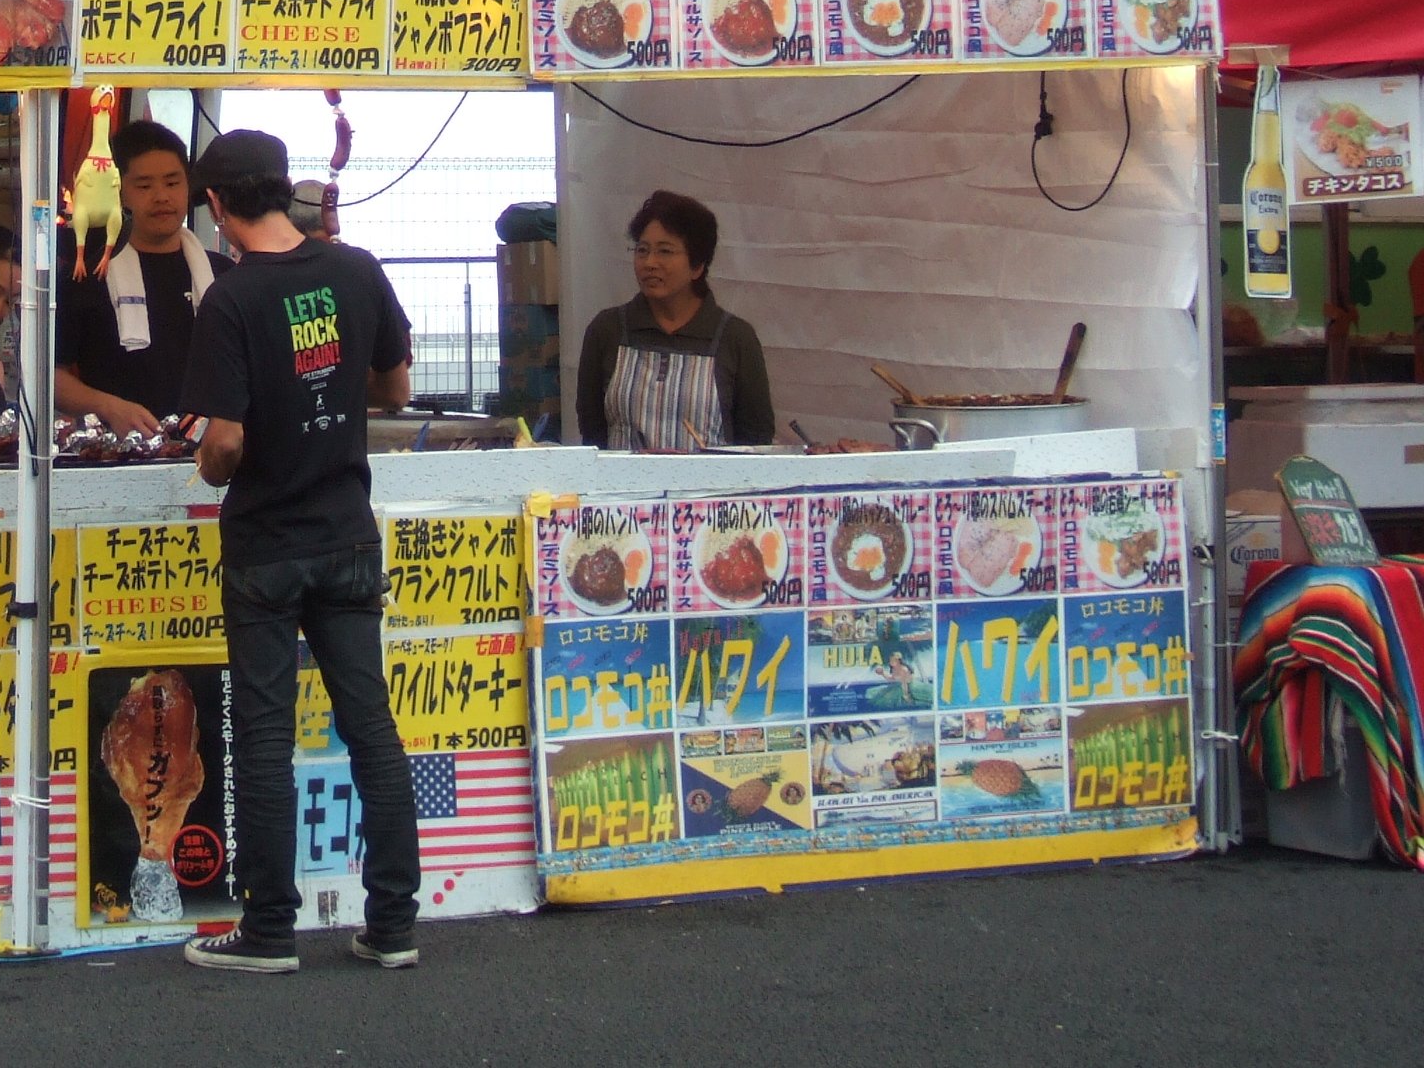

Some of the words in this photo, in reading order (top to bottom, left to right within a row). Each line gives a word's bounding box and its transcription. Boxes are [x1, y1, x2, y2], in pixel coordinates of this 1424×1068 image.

[81, 0, 223, 42] ポテトフライ!
[241, 26, 360, 43] CHEESE
[394, 10, 523, 56] ジャンボフランク!
[772, 35, 814, 62] 500円
[911, 28, 951, 55] 500円
[1047, 26, 1086, 53] 500円
[1176, 25, 1214, 51] 500円
[85, 52, 136, 65] にんにく!
[163, 44, 227, 67] 400円
[318, 47, 380, 70] 400円
[395, 57, 446, 70] Hawaii
[460, 57, 522, 72] 300円
[627, 38, 670, 67] 500円
[1308, 173, 1402, 194] チキンタコス
[1250, 191, 1283, 207] Corona
[283, 286, 337, 324] LET'S
[290, 314, 340, 352] ROCK
[295, 342, 342, 375] AGAIN!
[1231, 545, 1280, 564] Corona
[83, 560, 225, 593] チーズポテトフライ
[388, 561, 522, 607] フランクフルト!
[540, 543, 562, 616] デミソース
[676, 537, 693, 608] サルサソース
[891, 572, 931, 599] 500円
[1019, 566, 1057, 592] 500円
[1142, 559, 1181, 585] 500円
[627, 585, 667, 613] 500円
[761, 577, 803, 605] 500円
[84, 595, 208, 616] CHEESE
[460, 606, 520, 624] 300円
[166, 616, 227, 639] 400円
[823, 645, 883, 670] HULA
[940, 614, 1060, 705] ハワイ
[389, 659, 522, 717] ワイルドターキー
[677, 635, 791, 717] ハワイ
[432, 726, 527, 750] 1本500円
